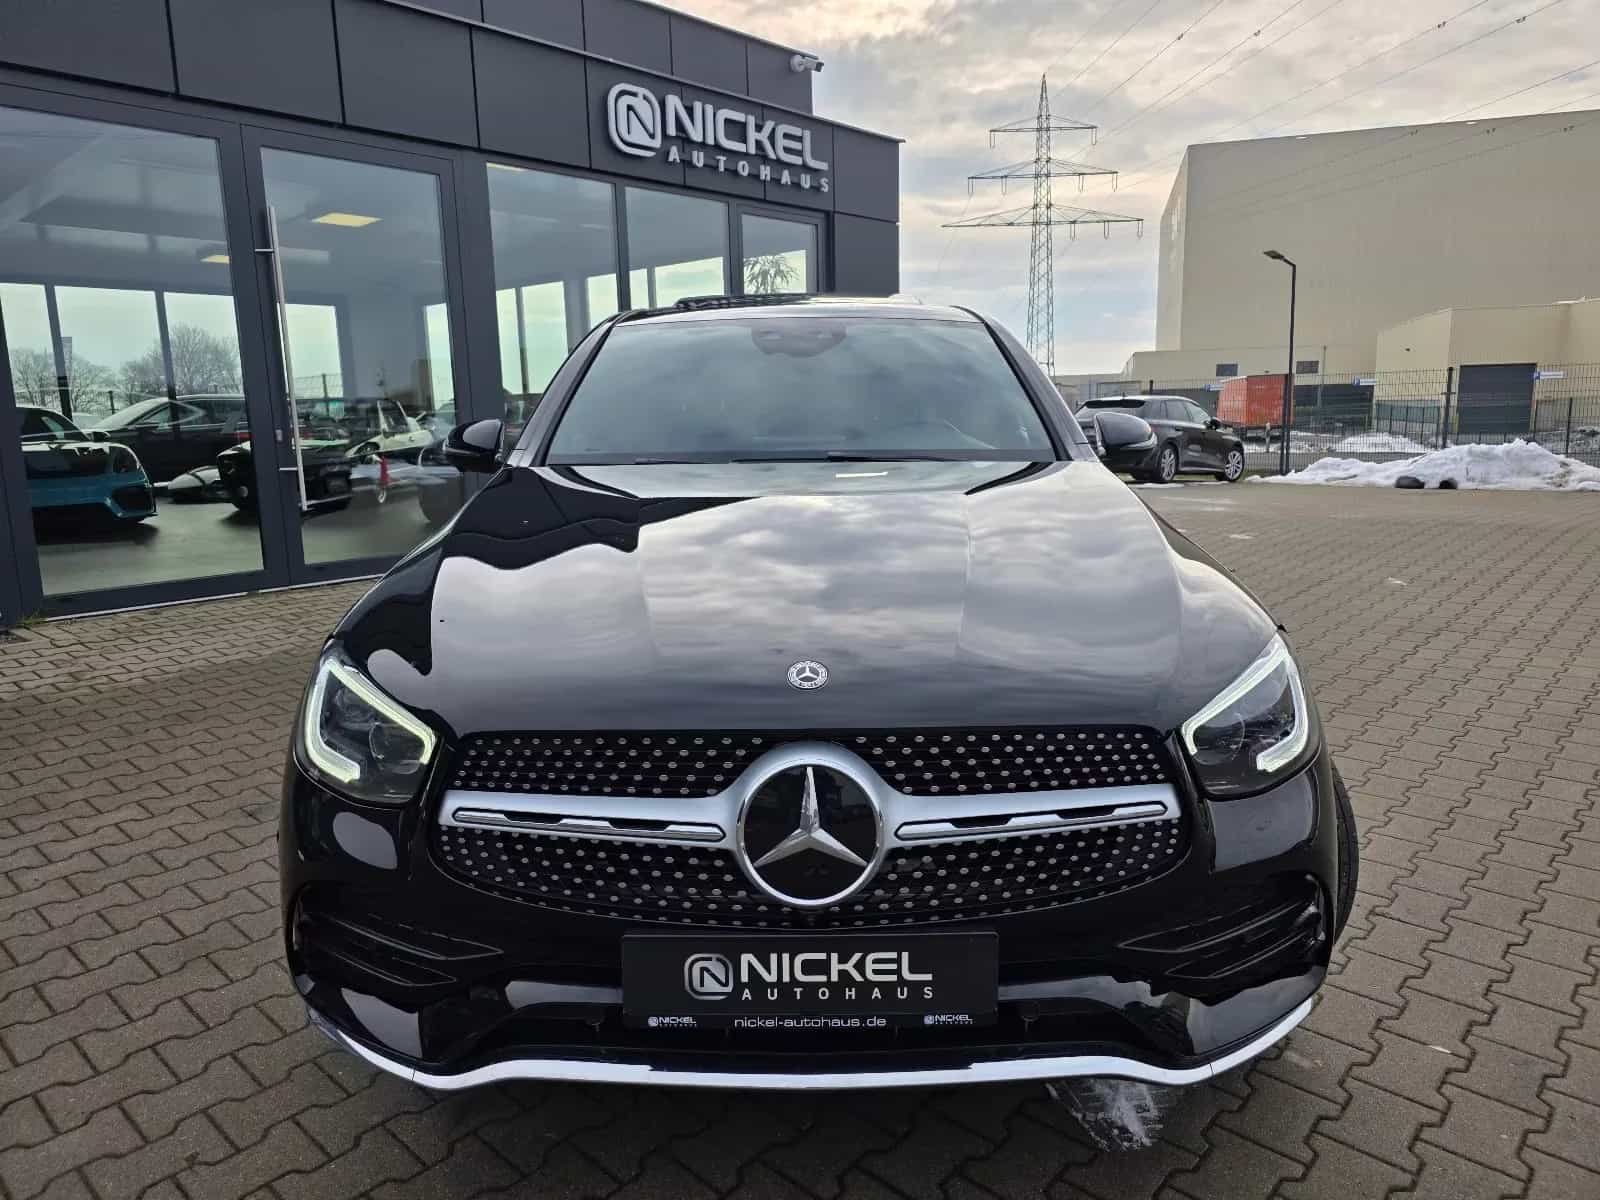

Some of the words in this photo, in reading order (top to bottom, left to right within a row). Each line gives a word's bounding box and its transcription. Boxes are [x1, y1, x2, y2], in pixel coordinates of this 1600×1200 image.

[664, 94, 829, 171] NICKEL
[667, 145, 829, 193] AUTOHAUS
[740, 951, 933, 982] NICKEL
[741, 986, 933, 1001] AUTOHAUS
[659, 1016, 697, 1024] NICKEL
[734, 1015, 887, 1028] nickel-autohaus.de
